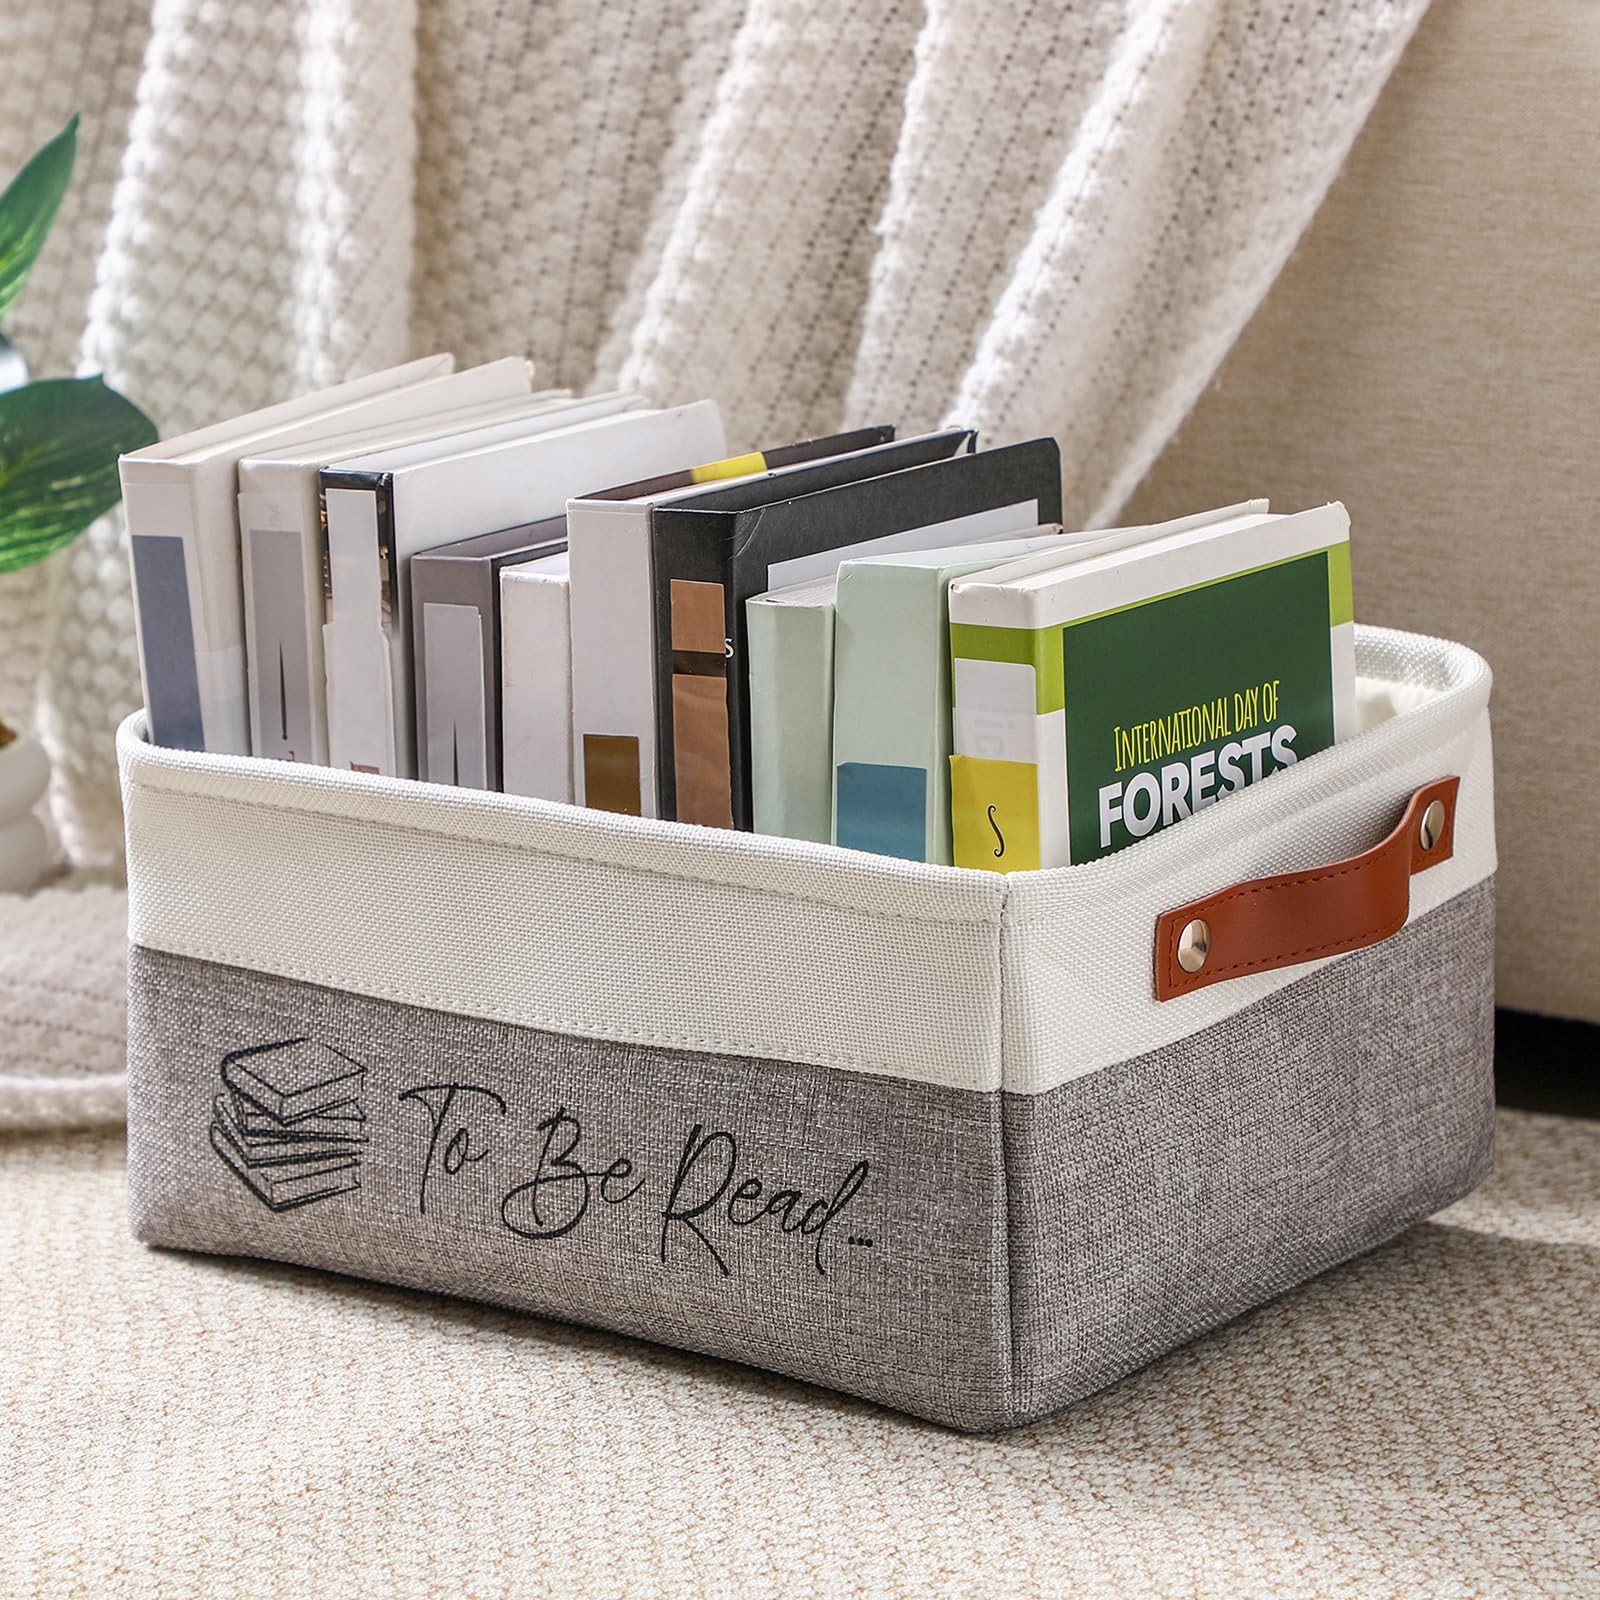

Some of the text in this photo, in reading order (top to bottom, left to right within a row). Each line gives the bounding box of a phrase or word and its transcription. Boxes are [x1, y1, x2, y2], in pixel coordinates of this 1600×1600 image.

[1098, 724, 1298, 849] FORESTS
[1113, 679, 1281, 773] INTERNATIONAL DAY OF
[400, 1083, 507, 1215] To
[501, 1106, 646, 1239] Be
